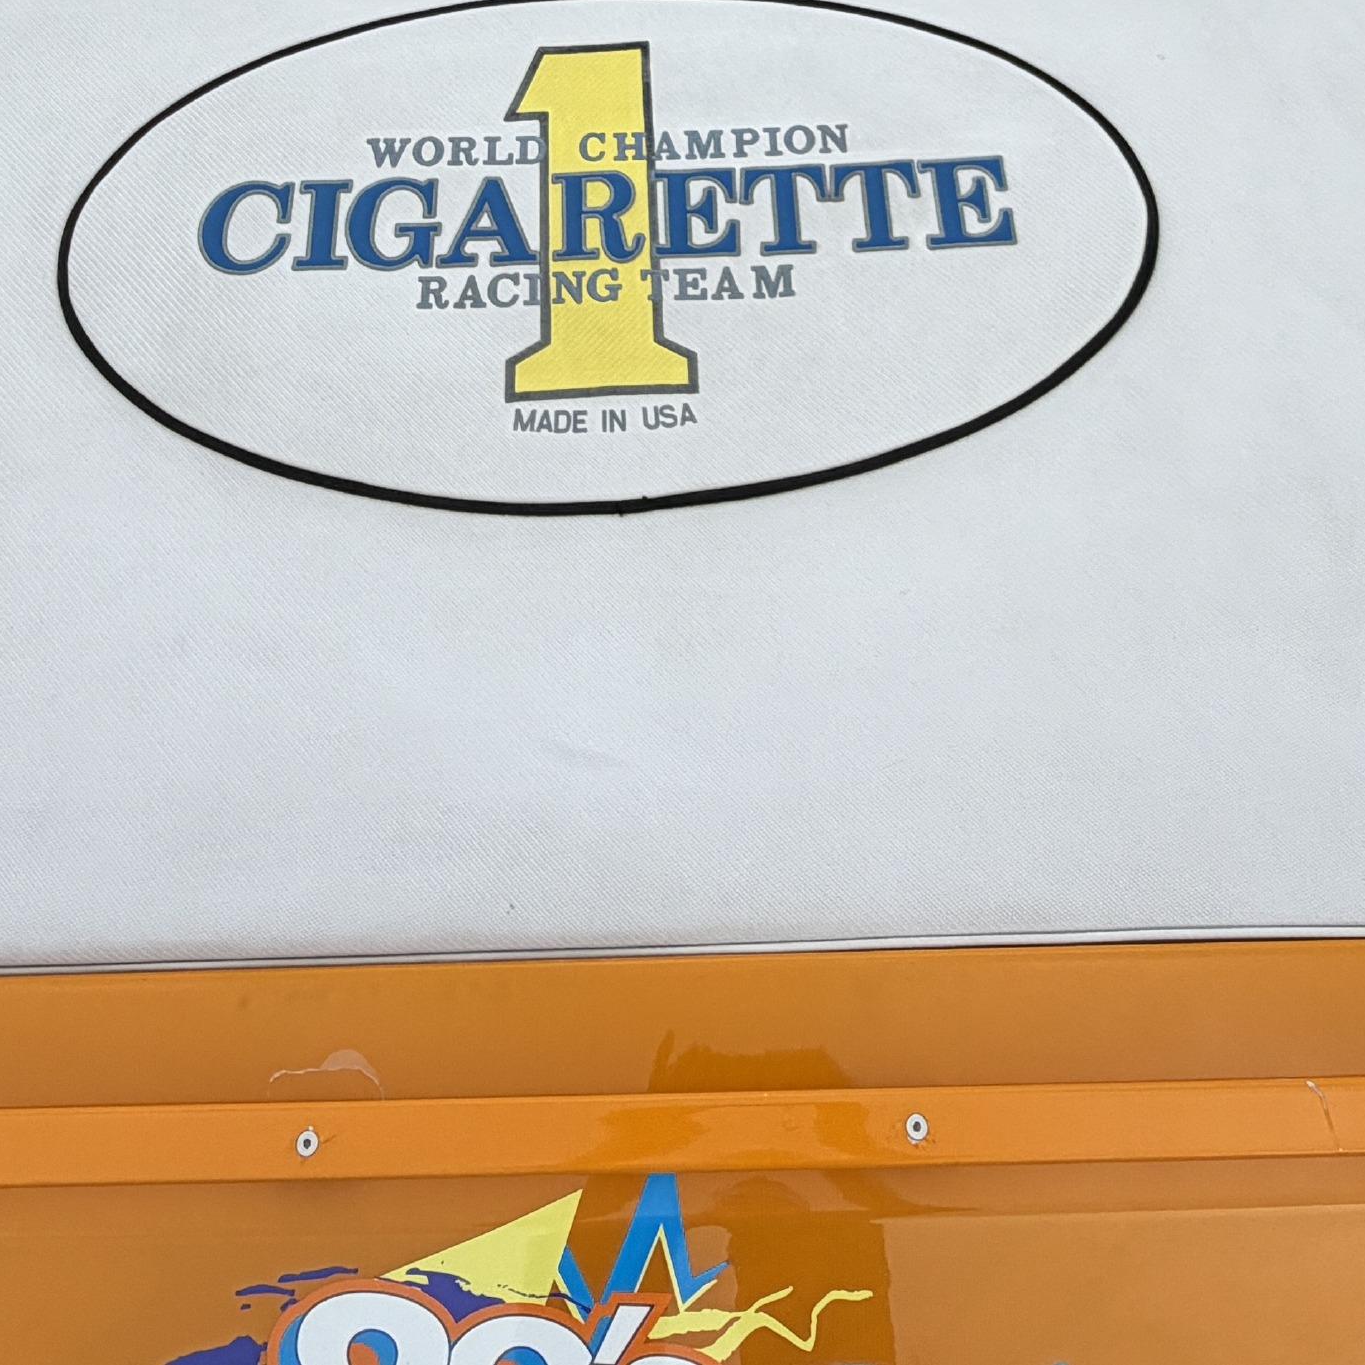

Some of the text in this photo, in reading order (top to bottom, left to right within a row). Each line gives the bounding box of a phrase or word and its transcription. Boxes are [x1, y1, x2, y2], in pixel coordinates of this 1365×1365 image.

[366, 123, 849, 169] WORLD CHAMPION
[197, 154, 1018, 276] CIGARETTE
[503, 40, 700, 403] 1
[415, 264, 797, 310] RACING TEAM
[512, 403, 698, 434] MADE IN USA
